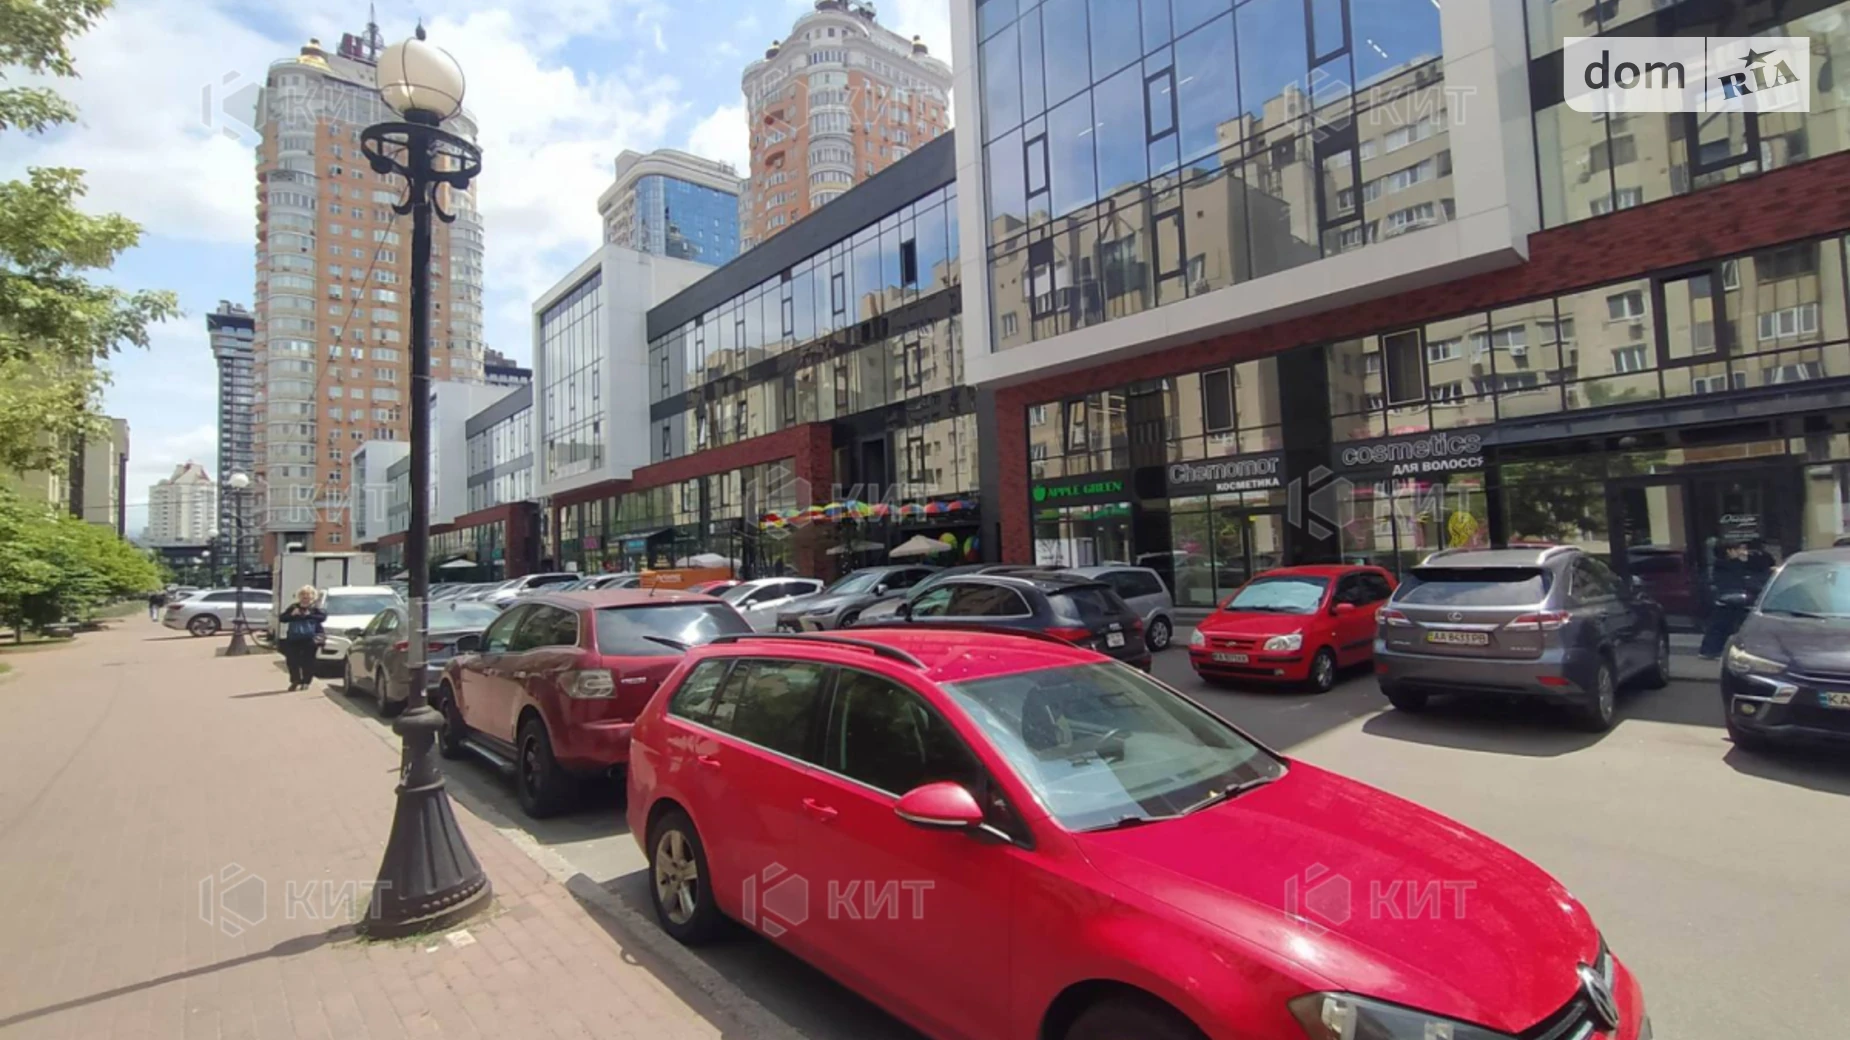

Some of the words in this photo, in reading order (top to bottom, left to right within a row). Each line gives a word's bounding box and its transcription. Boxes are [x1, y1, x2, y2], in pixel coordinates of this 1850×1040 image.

[1342, 433, 1481, 466] cosmetics
[1169, 457, 1279, 484] Chernomor
[1392, 464, 1419, 476] ДЛЯ
[1048, 486, 1080, 497] APPLE
[1083, 481, 1122, 494] GREEN
[1216, 477, 1280, 491] КОСМЕТИКА
